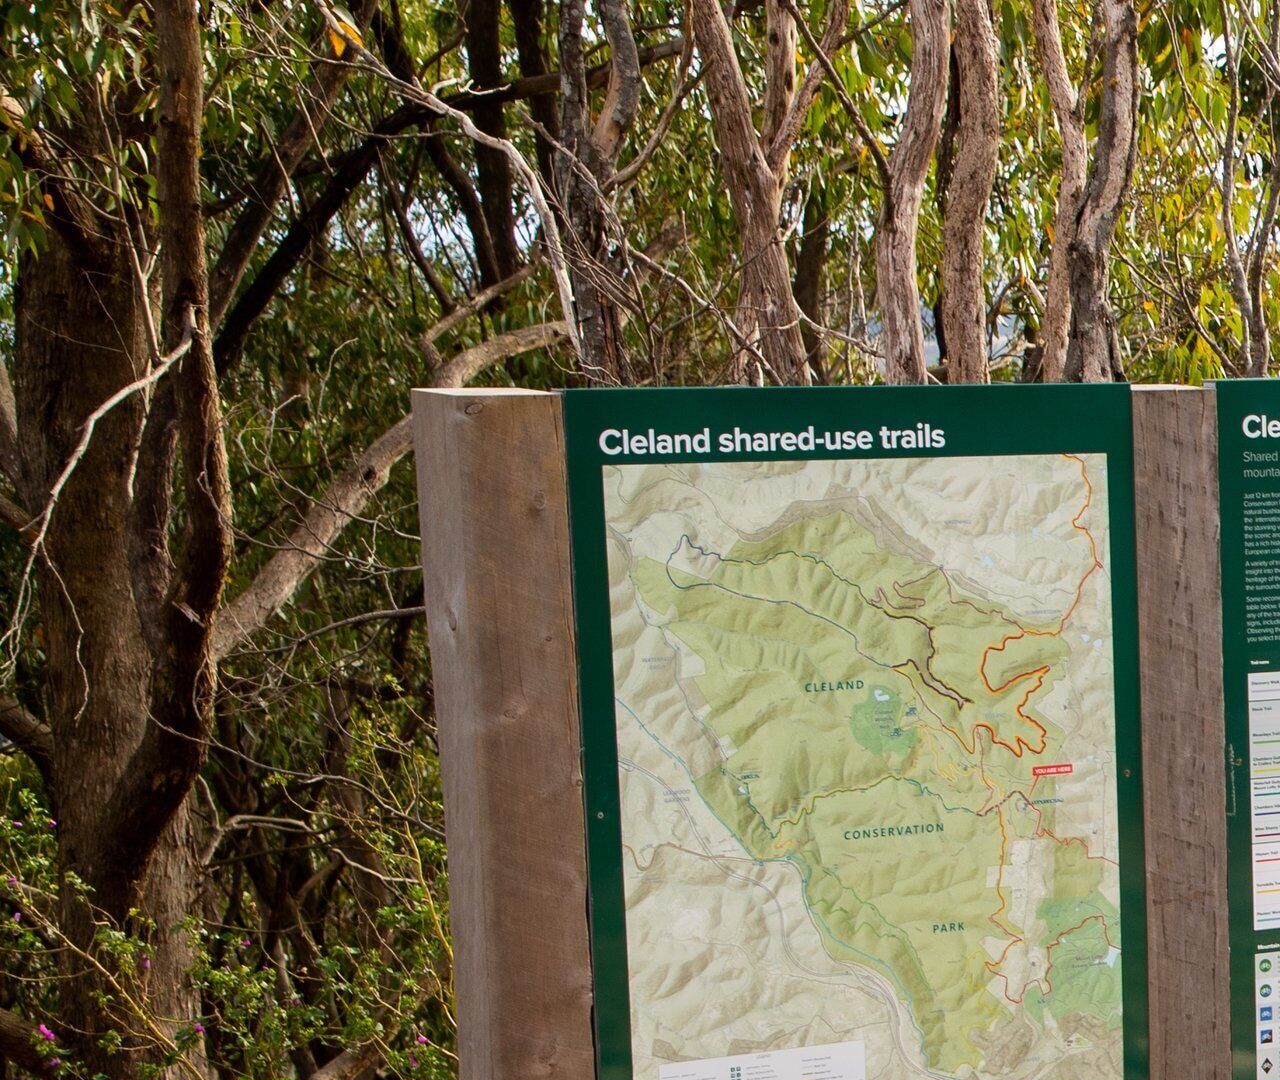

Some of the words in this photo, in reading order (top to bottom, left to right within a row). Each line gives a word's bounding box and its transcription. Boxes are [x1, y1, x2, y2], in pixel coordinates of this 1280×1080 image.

[599, 426, 711, 454] Cleland
[719, 424, 873, 452] shared-use
[881, 422, 945, 449] trails
[1243, 449, 1279, 462] Shared
[804, 680, 864, 692] CLELAND
[844, 823, 944, 840] CONSERVATION
[933, 922, 965, 934] PARK
